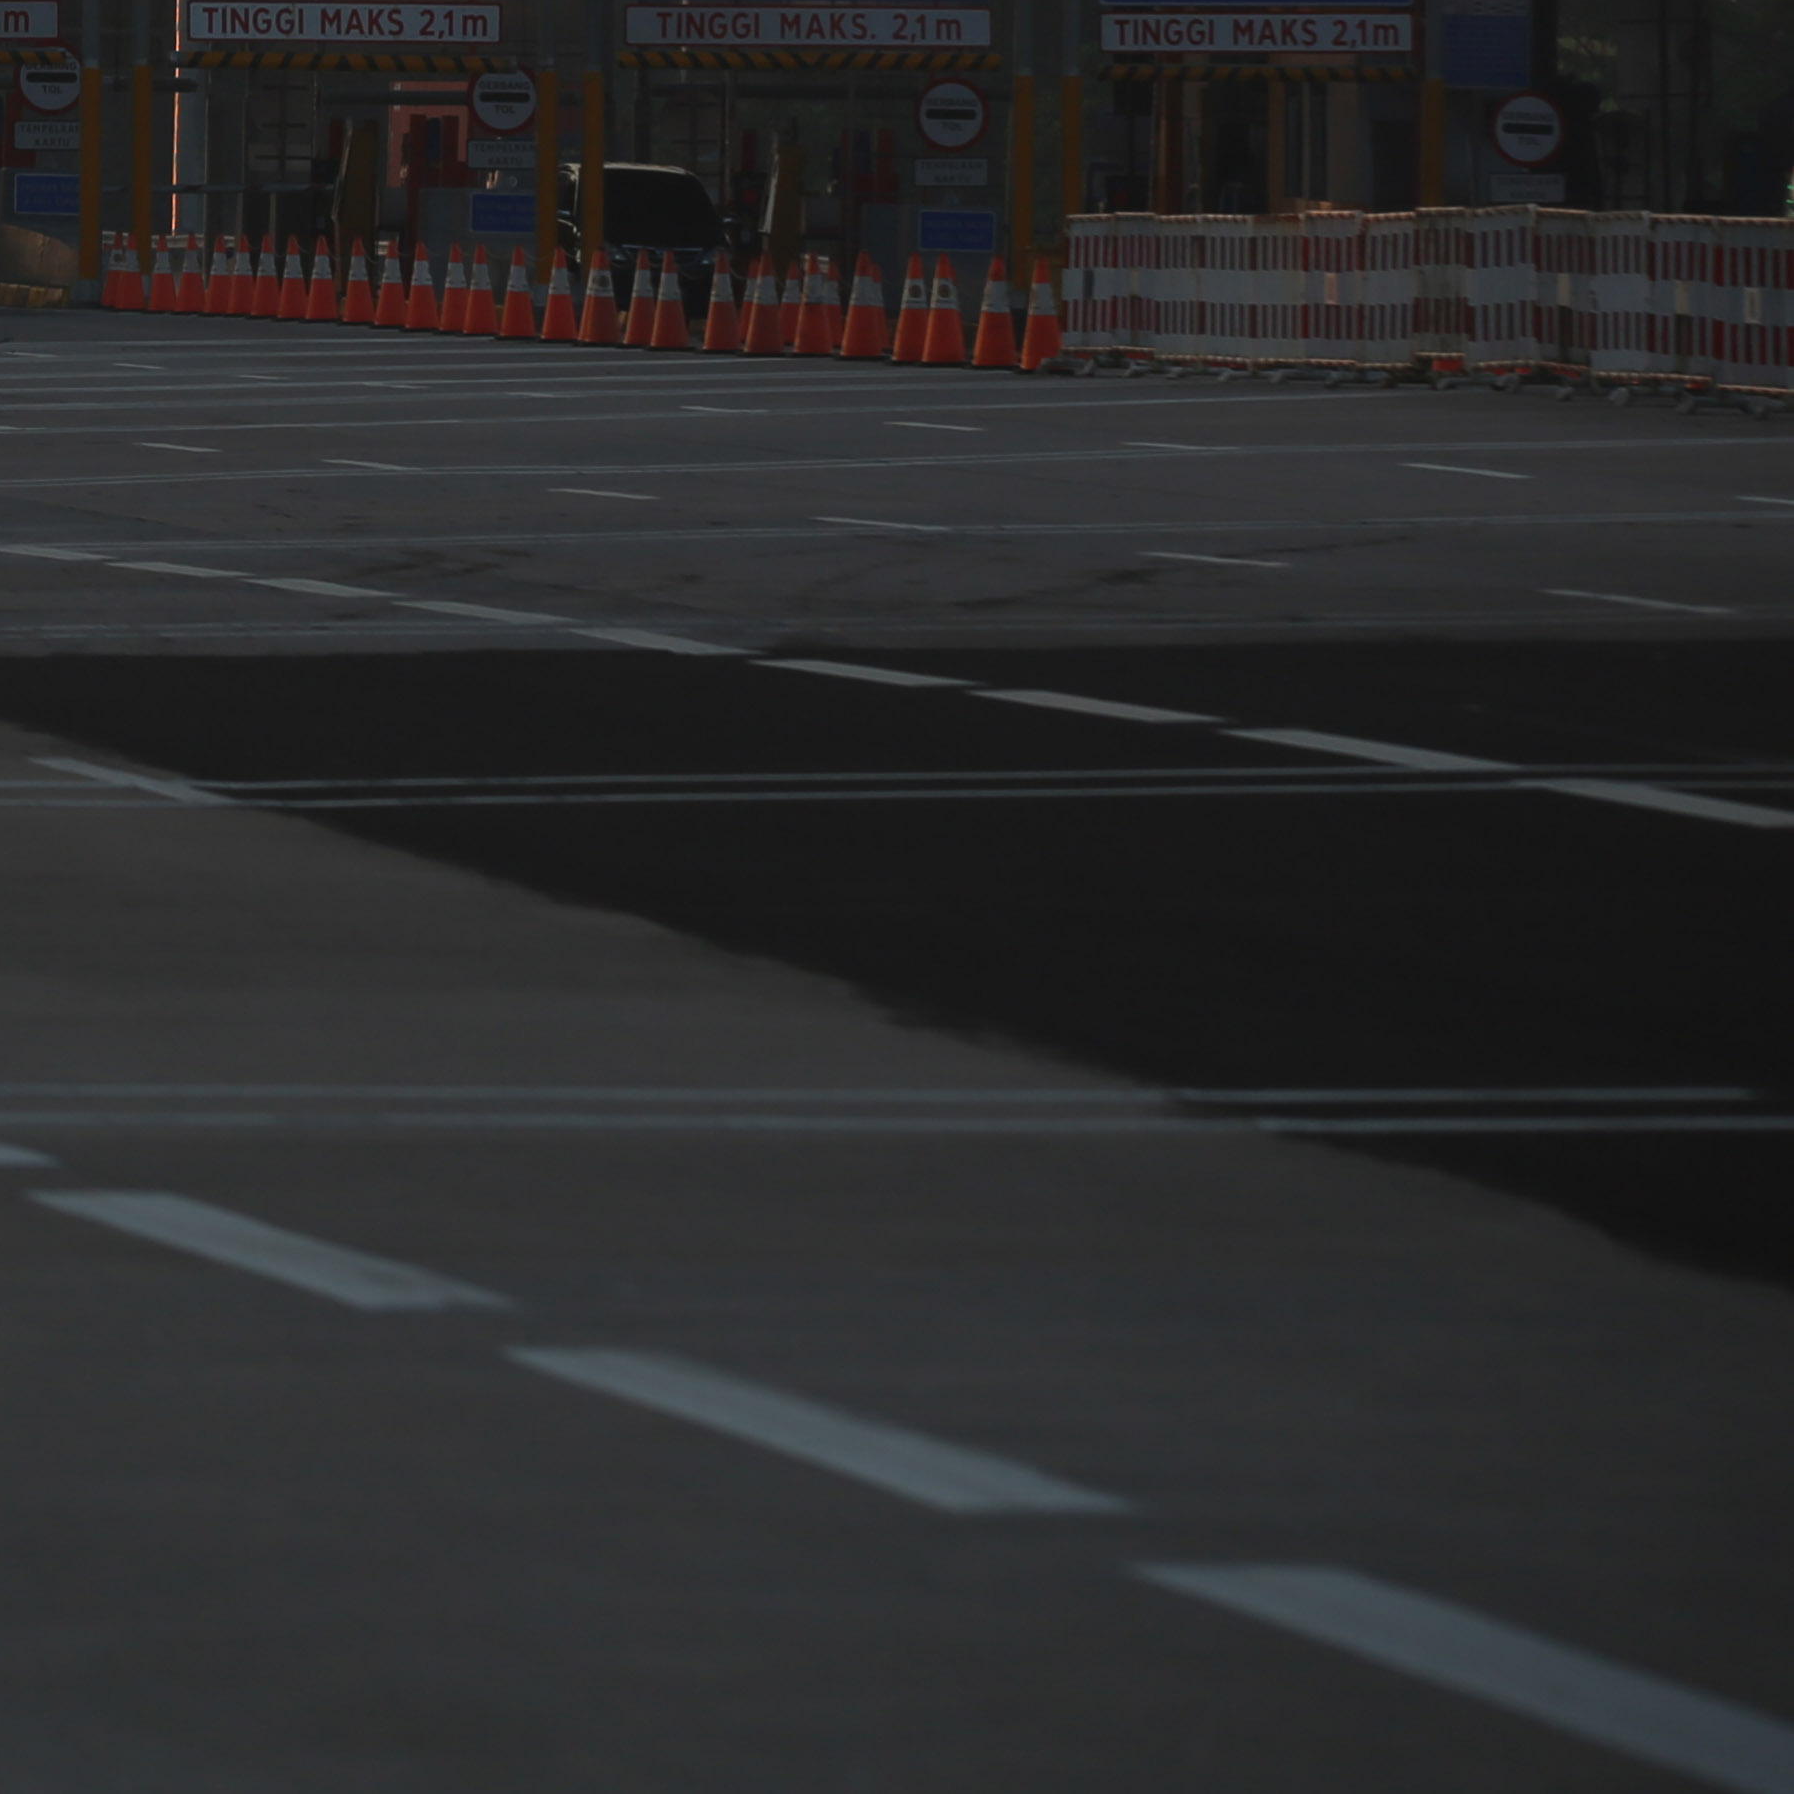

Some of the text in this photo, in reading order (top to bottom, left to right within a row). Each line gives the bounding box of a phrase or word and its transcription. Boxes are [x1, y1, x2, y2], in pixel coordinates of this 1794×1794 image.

[202, 7, 303, 36] TINGGI
[321, 8, 404, 36] MAKS
[656, 12, 759, 39] TINGGI
[780, 13, 876, 40] MAKS.
[1114, 19, 1214, 46] TINGGI
[1233, 19, 1317, 46] MAKS
